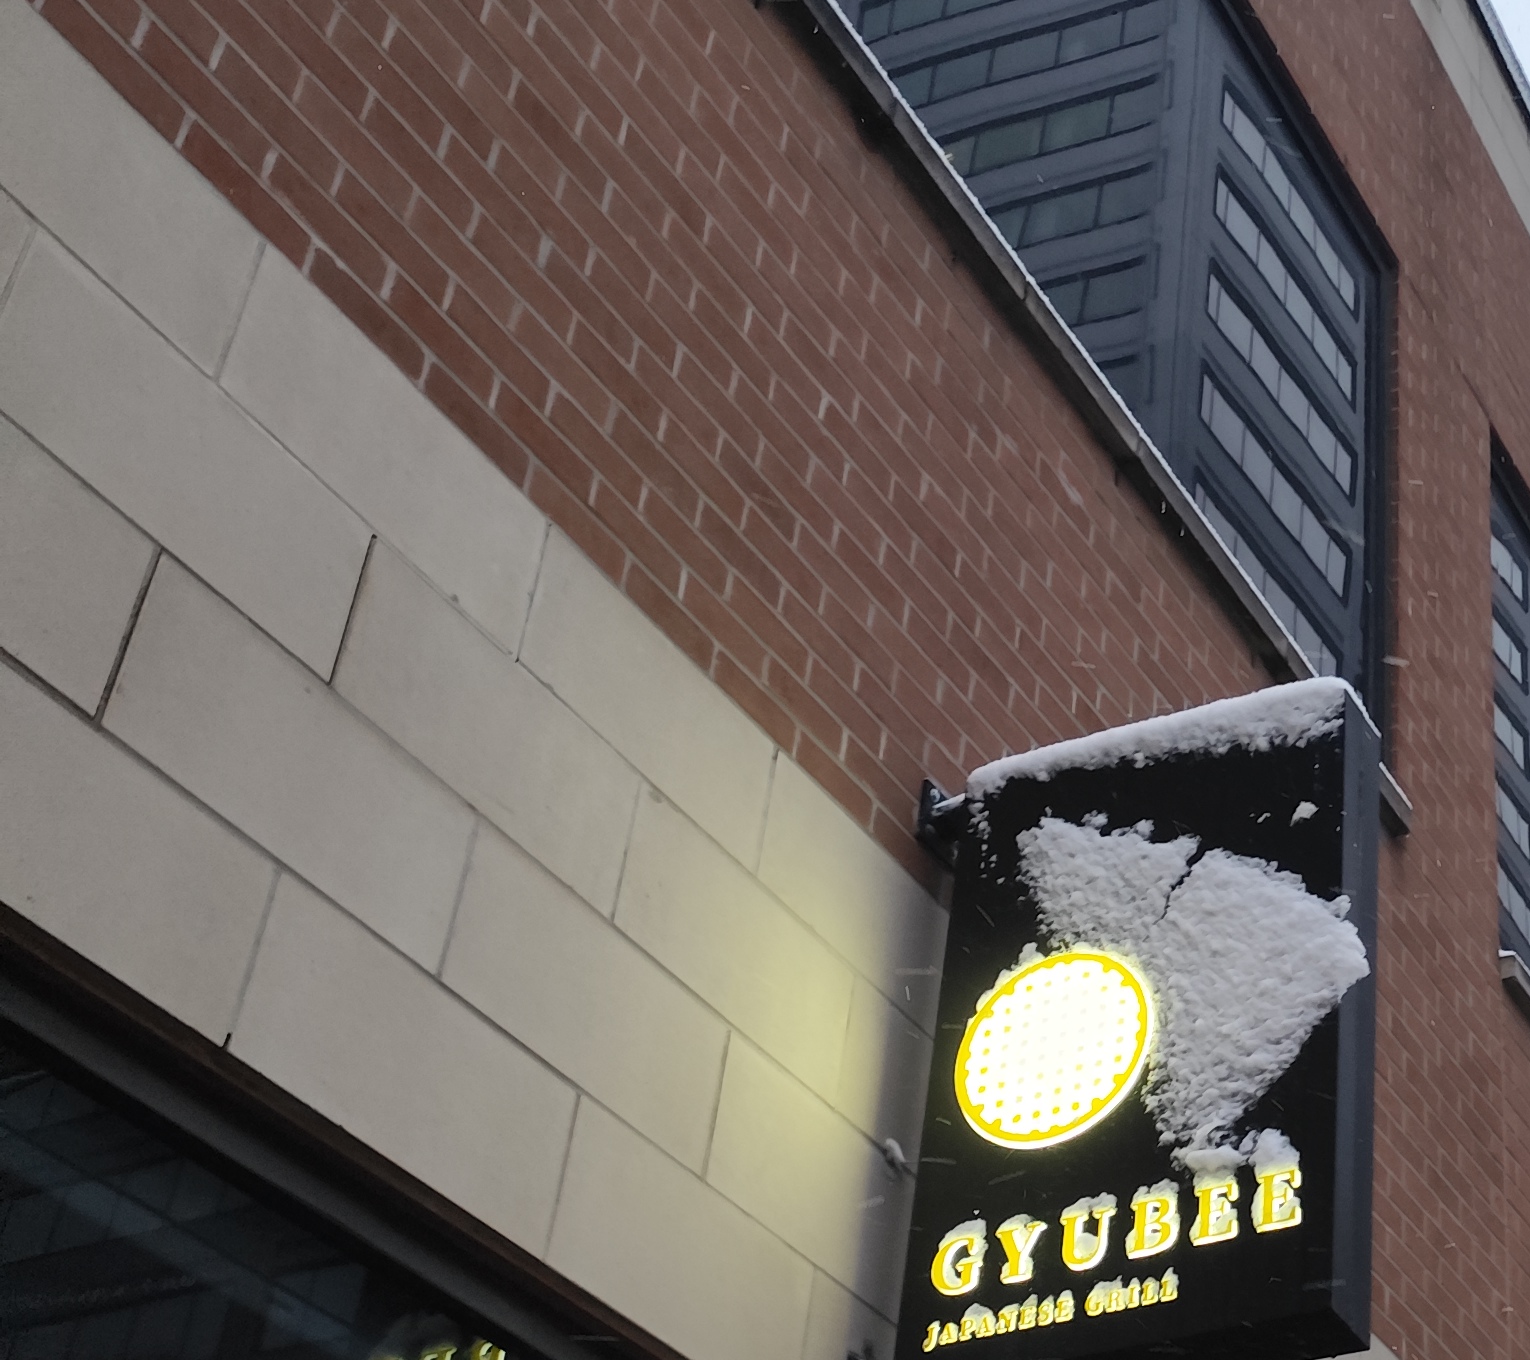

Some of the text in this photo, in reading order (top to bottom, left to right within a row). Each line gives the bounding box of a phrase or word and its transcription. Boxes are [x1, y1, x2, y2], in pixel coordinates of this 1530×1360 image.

[930, 1169, 1302, 1296] GYUBEE
[922, 1271, 1181, 1352] JAPANESE GRILL
